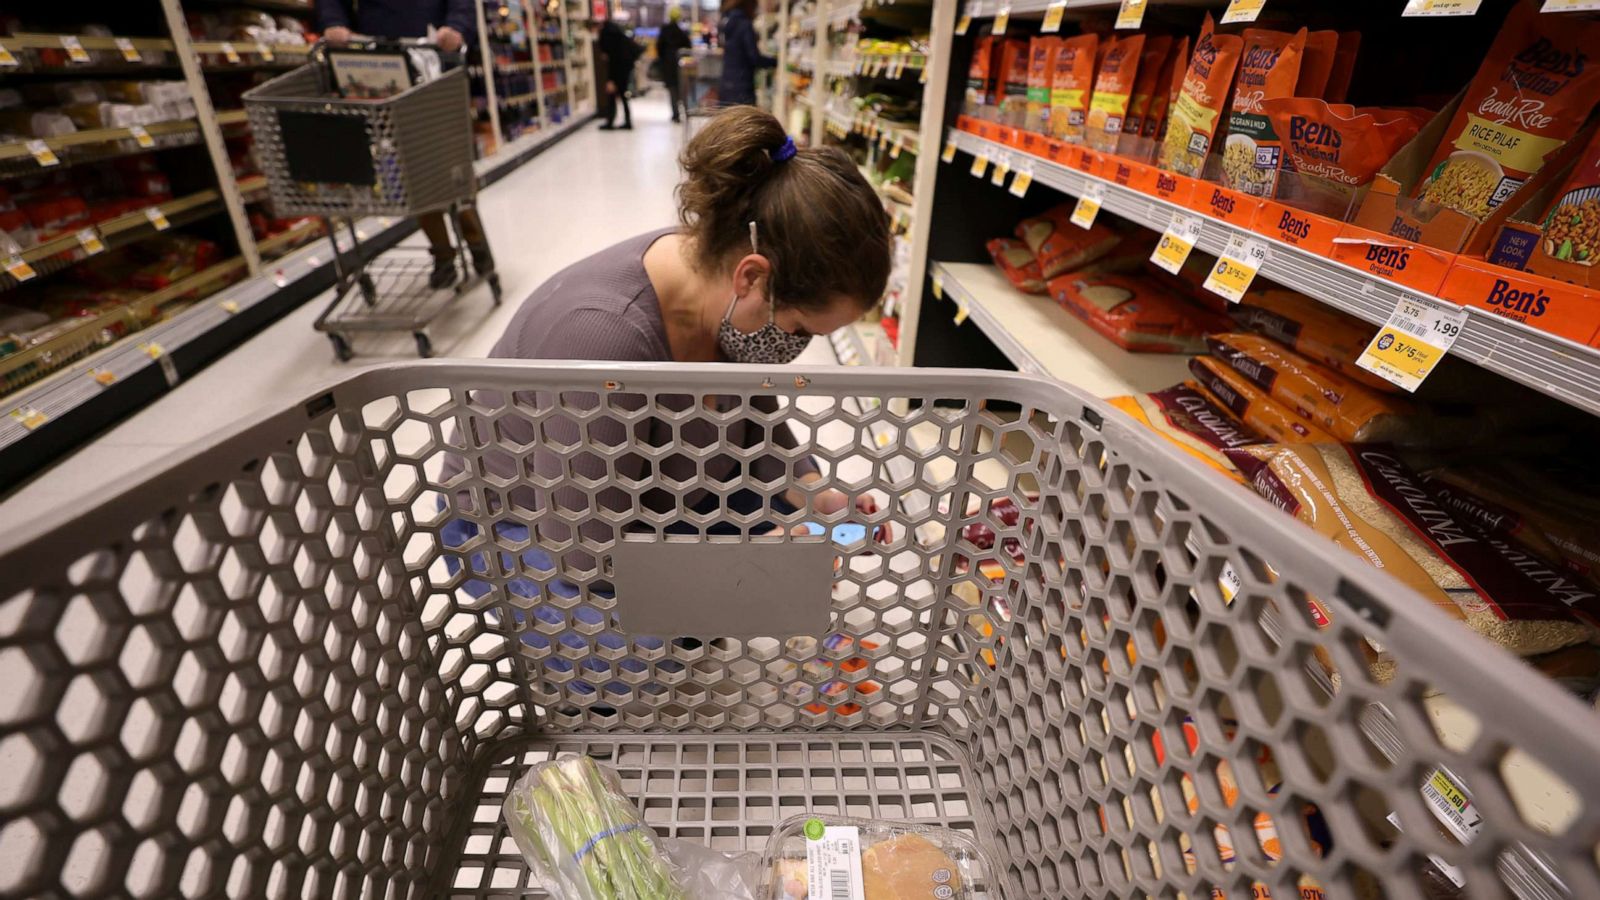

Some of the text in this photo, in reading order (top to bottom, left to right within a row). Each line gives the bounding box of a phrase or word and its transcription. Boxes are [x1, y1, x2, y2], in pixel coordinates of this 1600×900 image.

[1243, 45, 1280, 70] Ben's
[1514, 38, 1587, 78] Ben's
[1469, 124, 1520, 150] RICE PILAF
[1291, 141, 1341, 163] Original
[1210, 188, 1236, 214] Ben's
[1278, 210, 1311, 239] Ben's
[1390, 216, 1422, 242] Ben's
[1250, 247, 1265, 260] 1.99
[1509, 236, 1529, 247] NEW
[1366, 244, 1410, 271] Ben's
[1369, 263, 1394, 277] Original
[1486, 279, 1551, 317] Ben's
[1403, 306, 1420, 318] 3.75
[1433, 319, 1459, 338] 1.99
[1361, 451, 1478, 550] CAROLINA
[1226, 570, 1241, 587] 4.99
[1446, 788, 1463, 808] 1.60
